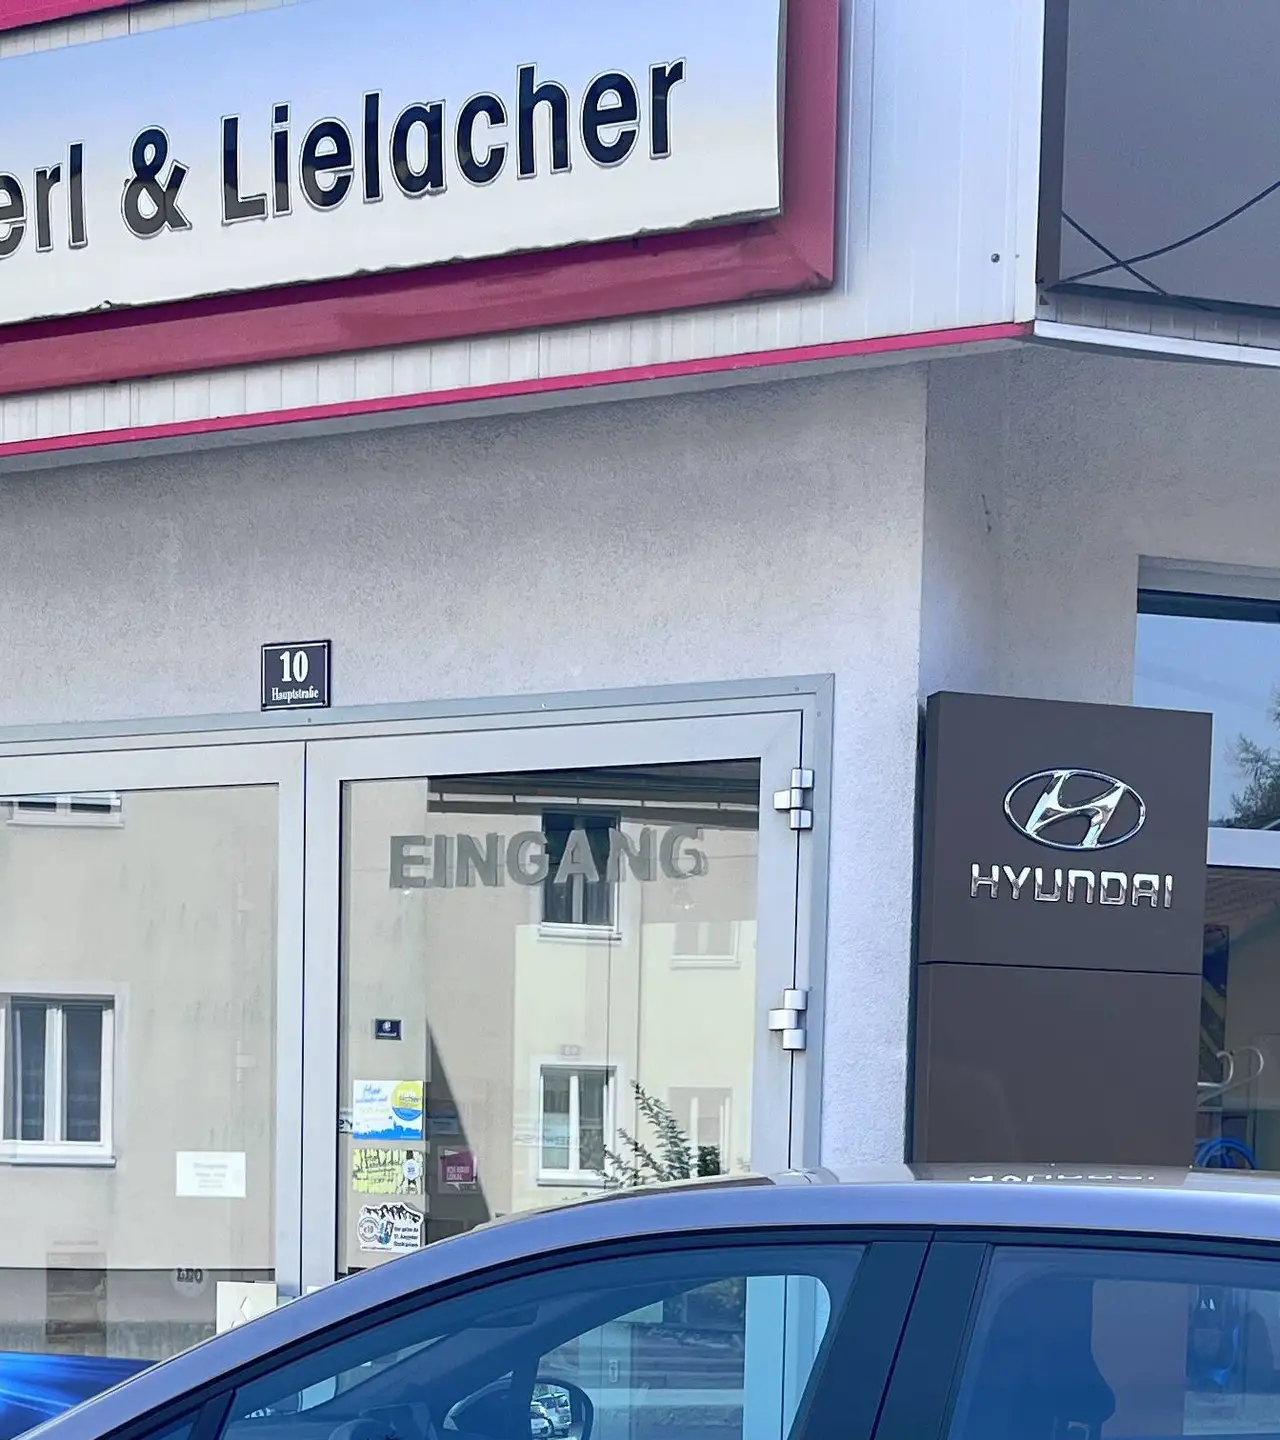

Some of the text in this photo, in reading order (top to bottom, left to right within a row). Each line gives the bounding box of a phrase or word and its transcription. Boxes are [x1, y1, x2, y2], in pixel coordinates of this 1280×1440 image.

[122, 126, 193, 239] &
[220, 56, 687, 225] Lielacher
[280, 650, 308, 682] 10
[271, 685, 319, 703] Hauptstraße
[388, 824, 708, 889] EINGANG
[970, 863, 1174, 909] HYUNDAI
